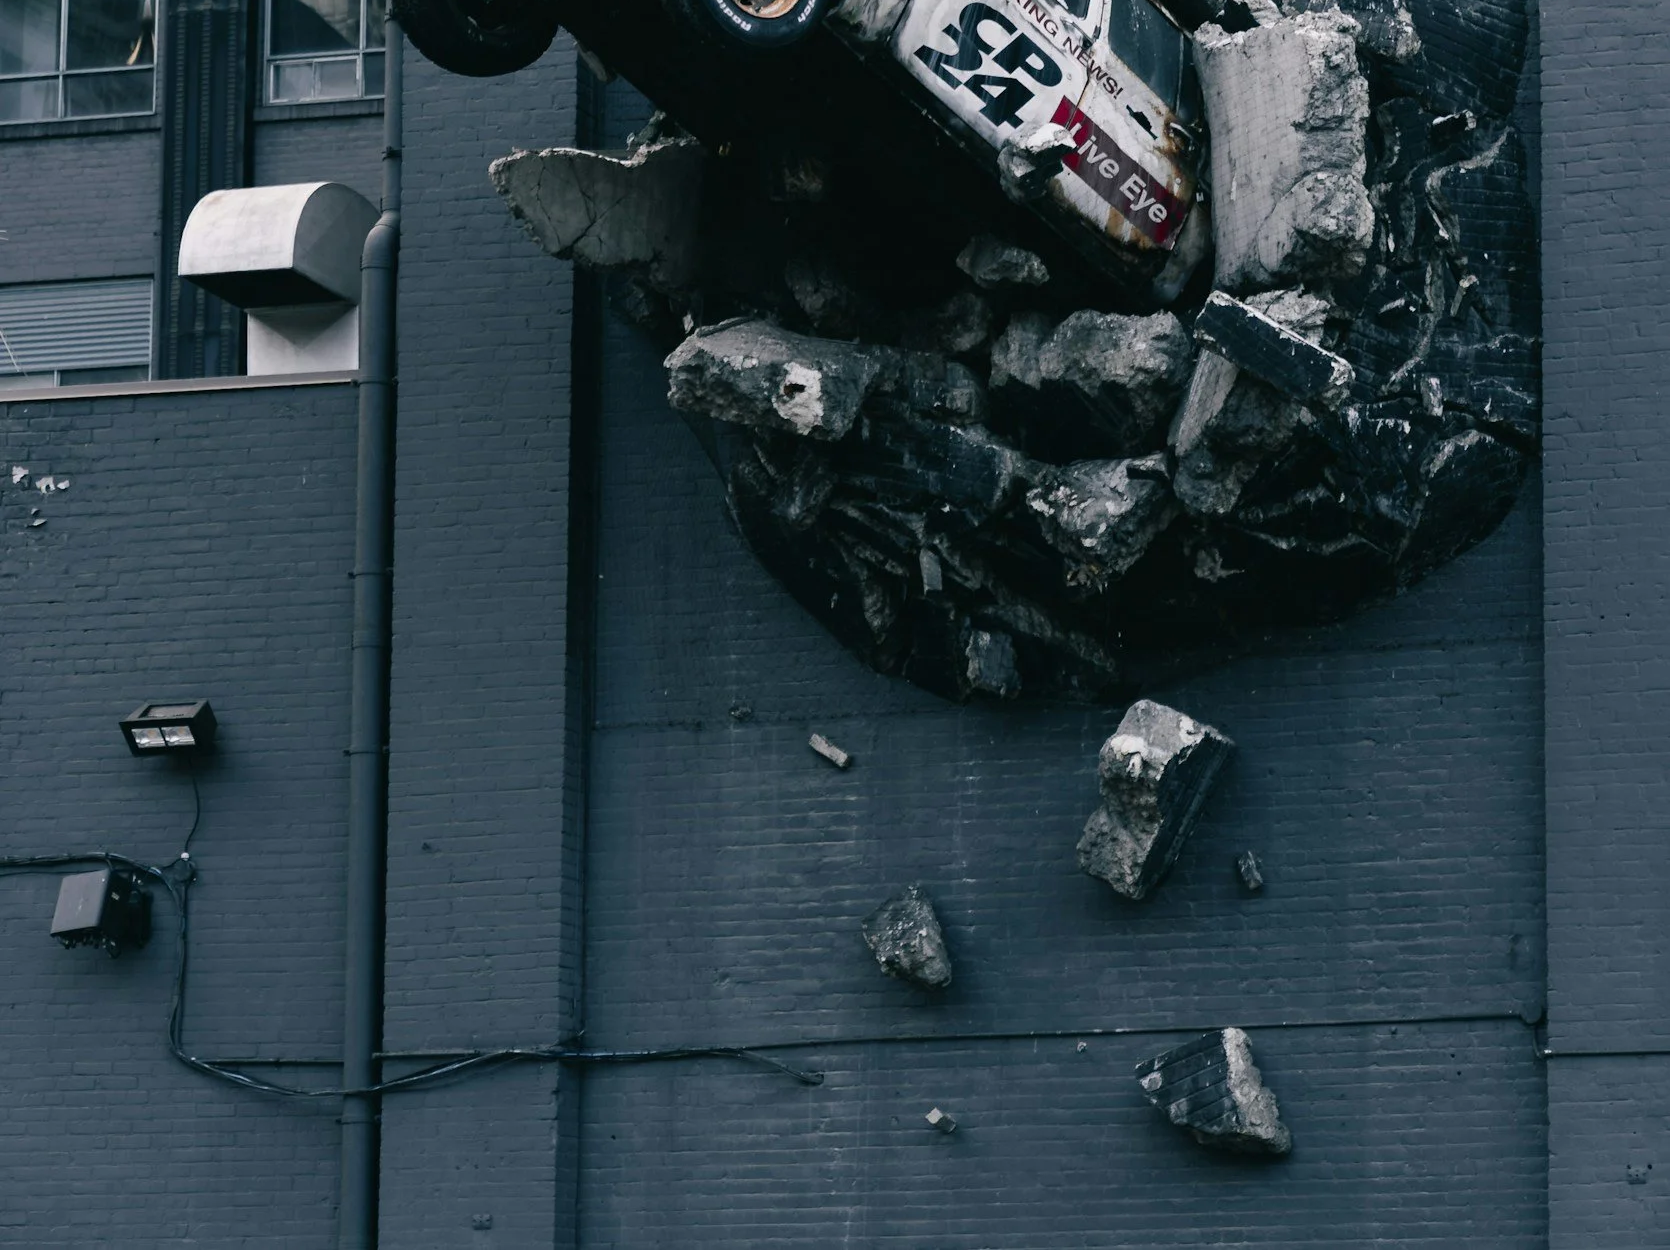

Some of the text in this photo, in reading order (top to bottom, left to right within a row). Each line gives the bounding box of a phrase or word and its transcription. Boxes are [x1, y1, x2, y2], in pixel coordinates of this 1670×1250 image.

[913, 23, 1036, 129] 24
[959, 2, 1063, 87] CP
[1062, 36, 1124, 100] NEWS!
[1119, 173, 1168, 223] Eye
